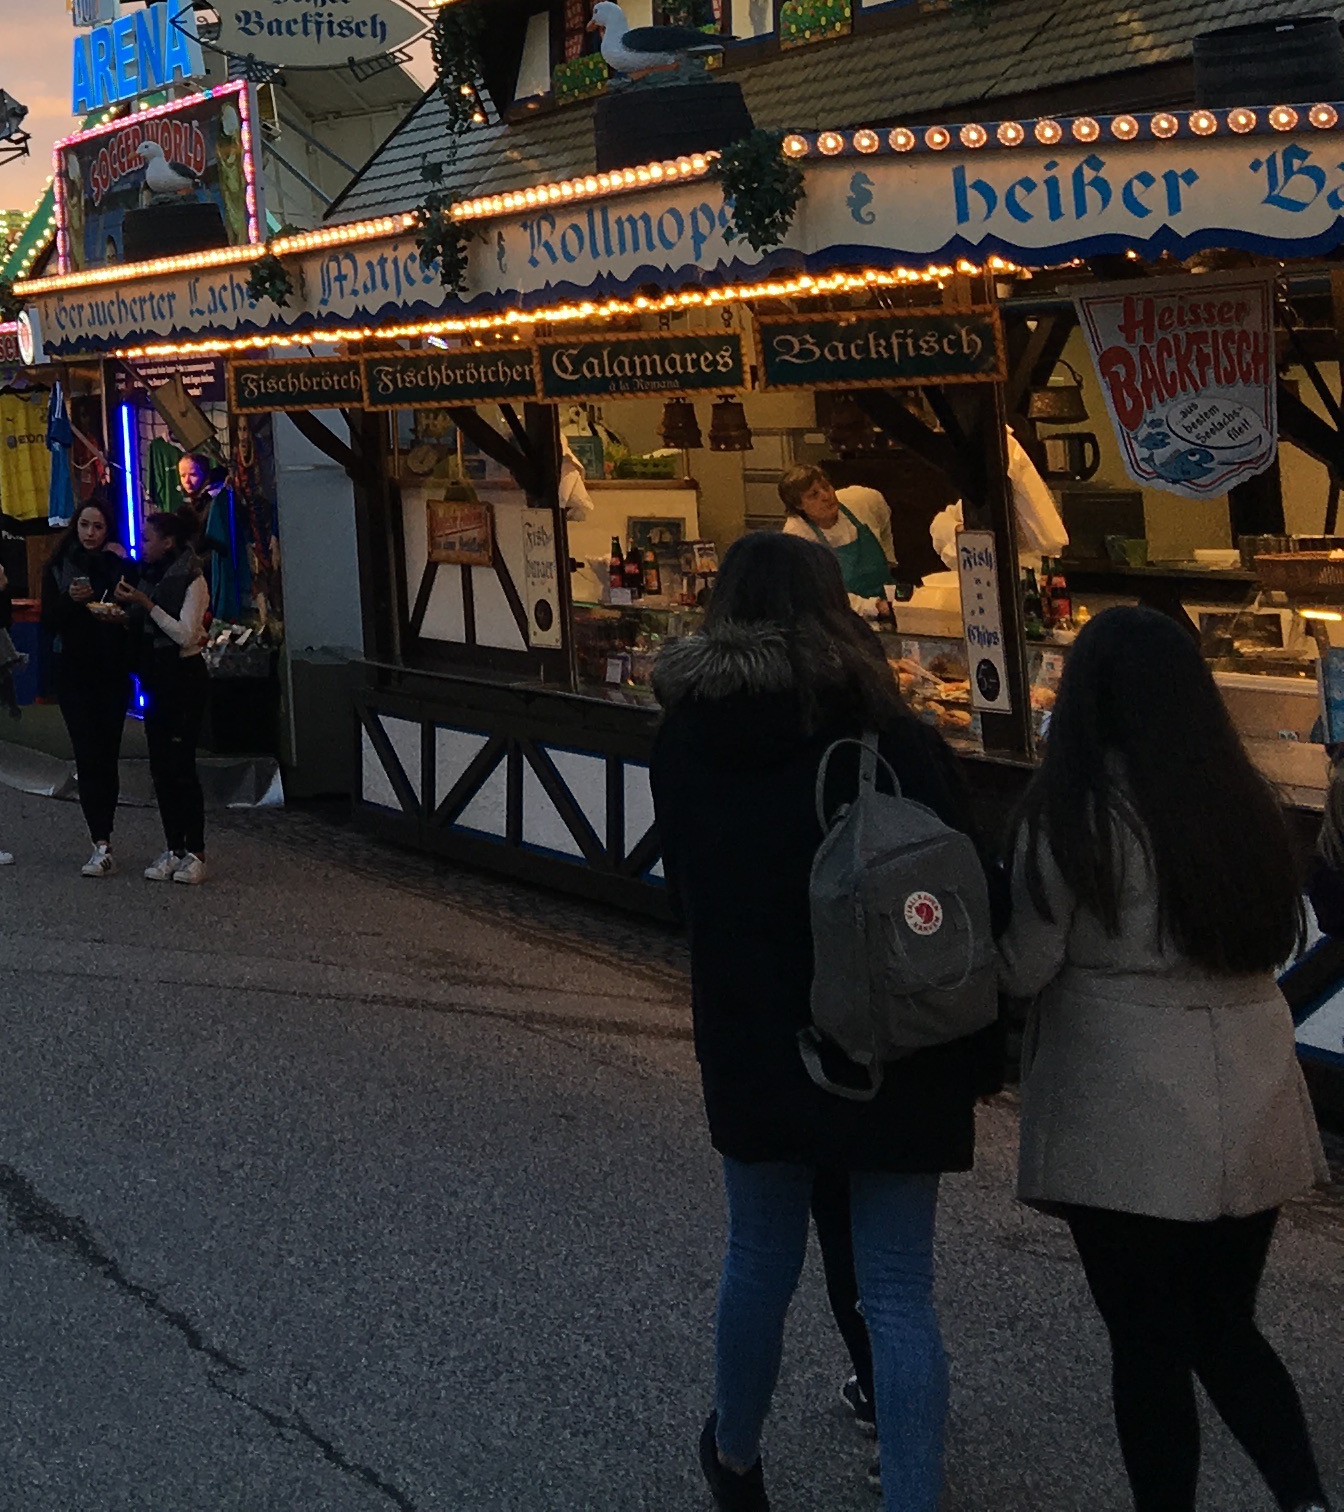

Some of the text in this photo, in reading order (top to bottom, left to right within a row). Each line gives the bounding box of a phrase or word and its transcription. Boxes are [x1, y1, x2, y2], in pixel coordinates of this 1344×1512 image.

[234, 10, 387, 45] Backfisch
[952, 153, 1200, 226] heißer
[1118, 295, 1248, 345] Heisser
[552, 345, 734, 381] Calamares
[773, 323, 983, 367] Backfisch
[1098, 329, 1270, 432] BACKFISCH
